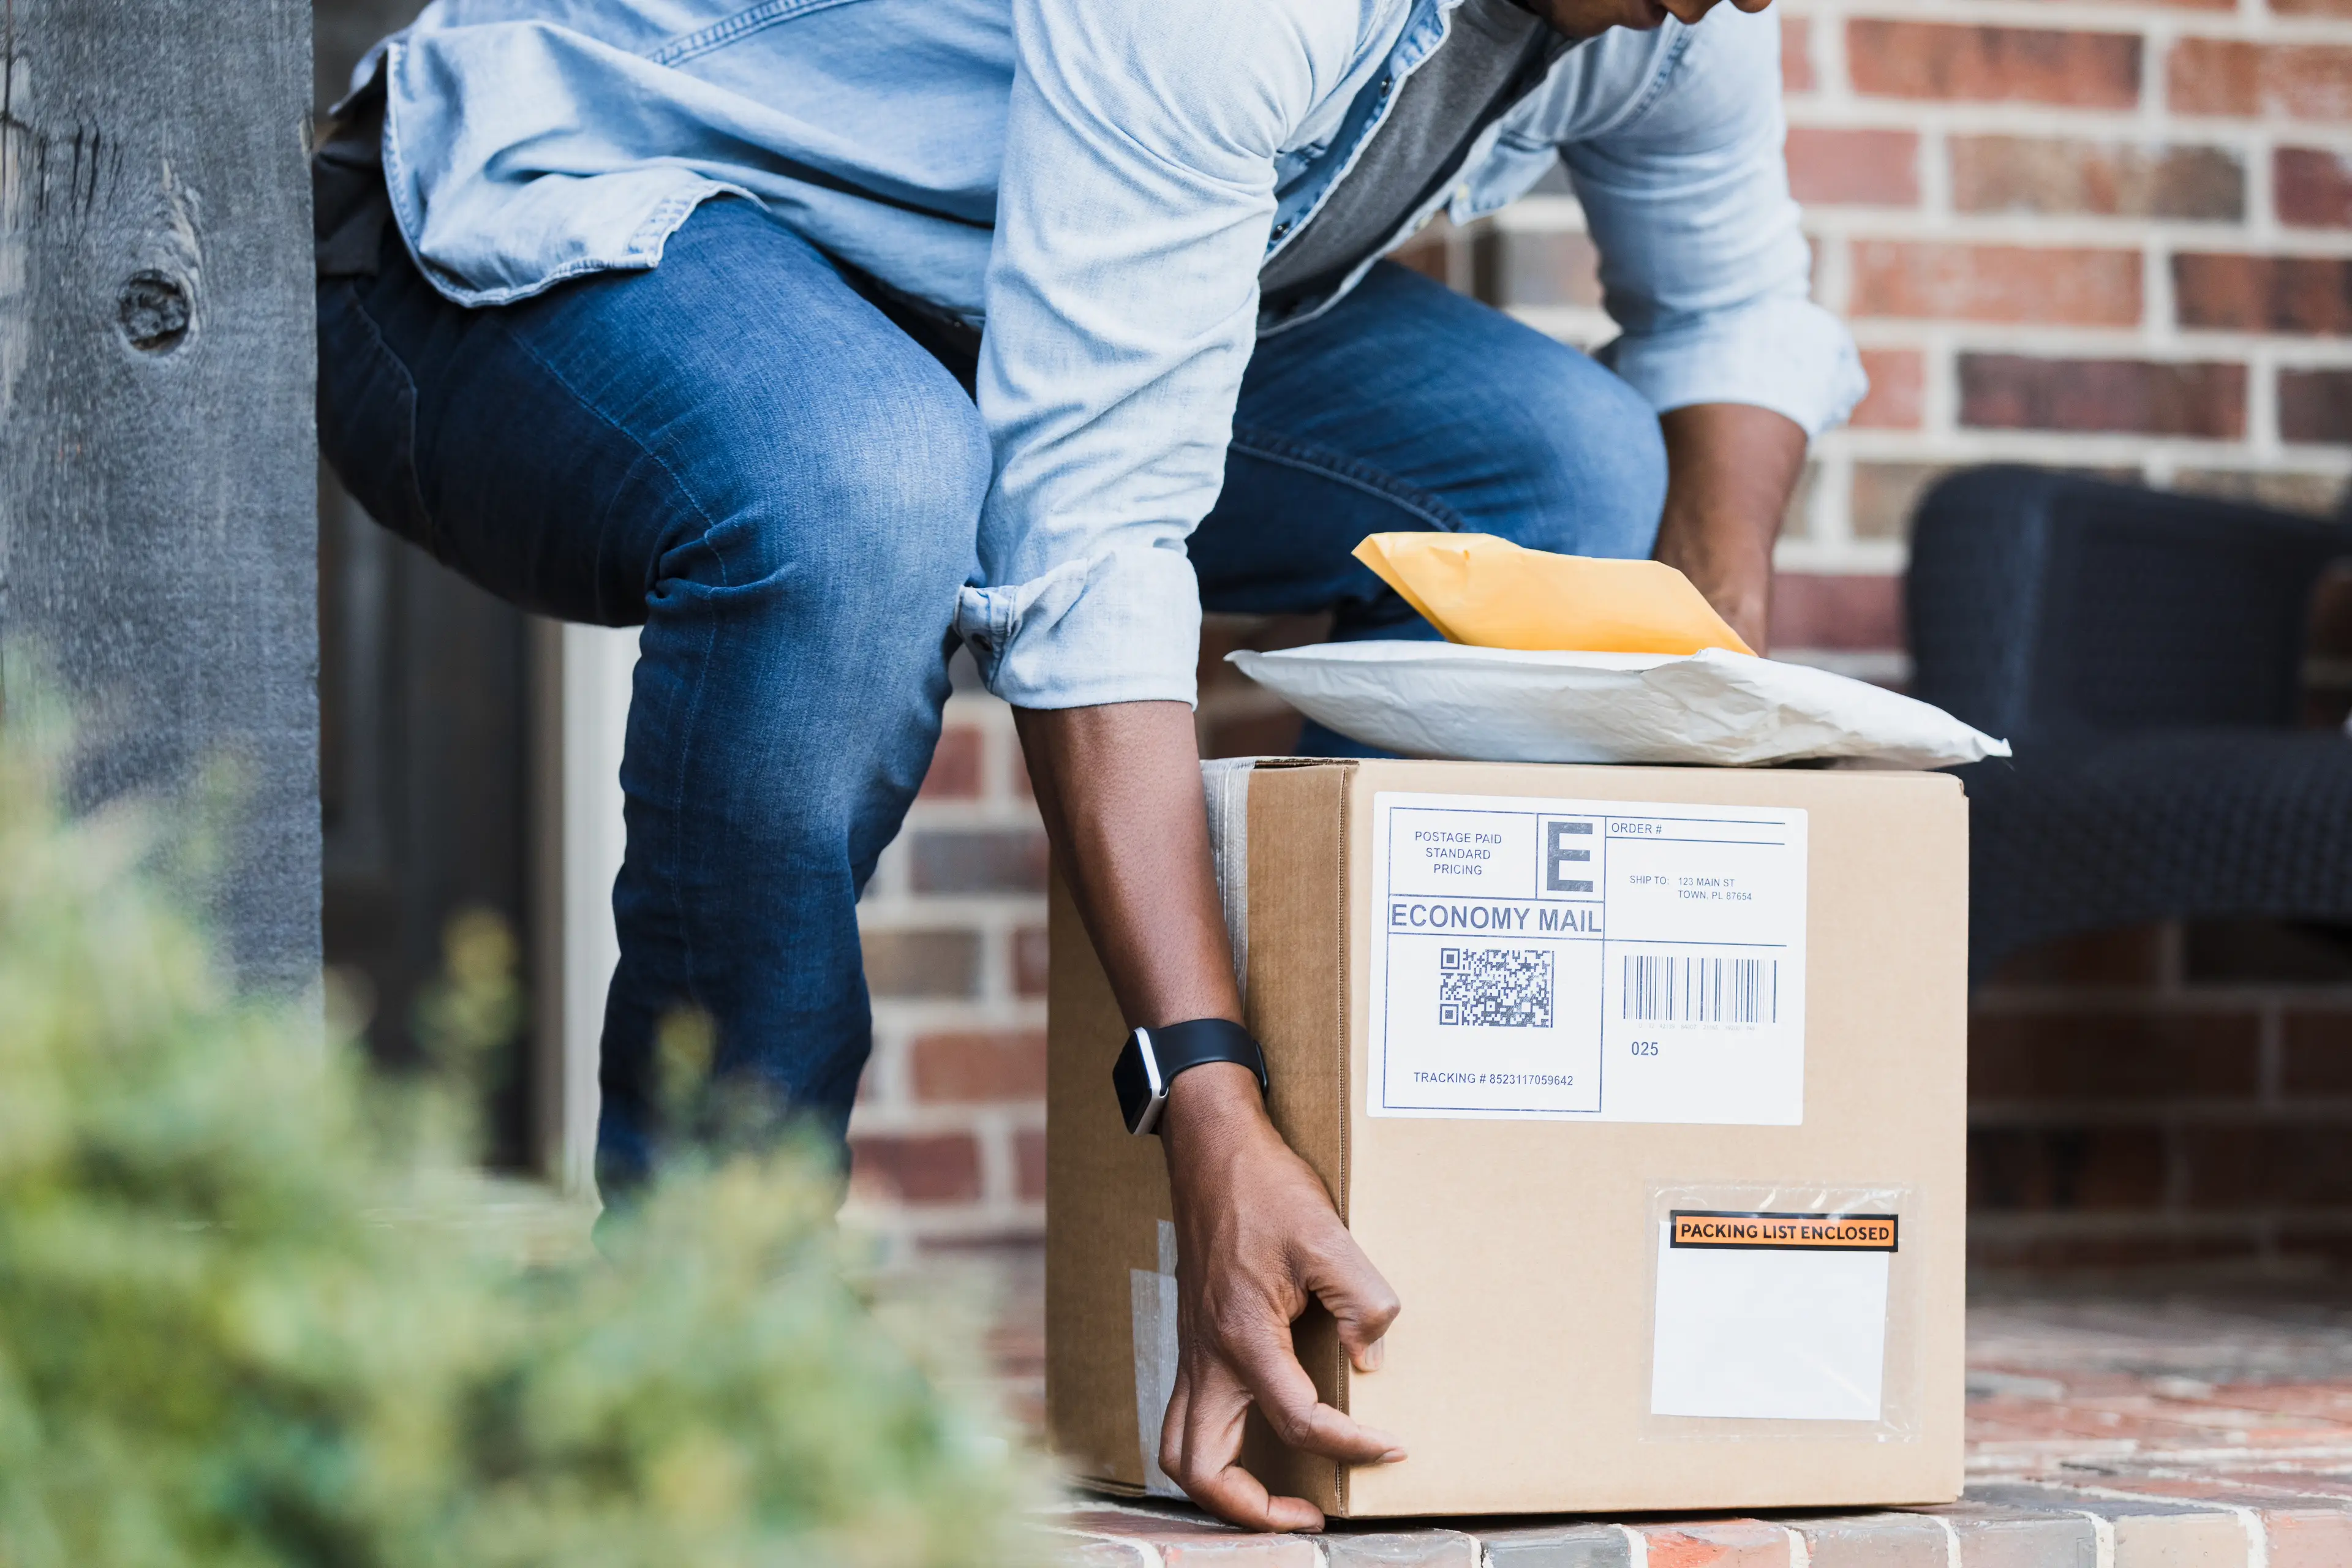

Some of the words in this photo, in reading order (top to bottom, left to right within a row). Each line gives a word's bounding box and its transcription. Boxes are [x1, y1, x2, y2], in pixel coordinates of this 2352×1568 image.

[1611, 823, 1652, 834] ORDER
[1656, 824, 1662, 834] #
[1415, 831, 1471, 843] POSTAGE
[1476, 833, 1502, 844] PAID
[1426, 847, 1490, 859] STANDARD
[1547, 821, 1594, 892] E
[1434, 864, 1482, 875] PRICING
[1630, 875, 1651, 884] SHIP
[1654, 876, 1670, 885] TO:
[1679, 877, 1694, 886] 123
[1697, 878, 1720, 886] MAIN
[1723, 878, 1735, 887] ST
[1678, 890, 1708, 900] TOWN,
[1712, 891, 1723, 900] PL
[1726, 892, 1752, 900] 87654
[1392, 903, 1531, 930] ECONOMY
[1539, 908, 1602, 933] MAIL
[1631, 1041, 1659, 1056] 025
[1414, 1072, 1476, 1084] TRACKING
[1479, 1073, 1487, 1084] #
[1490, 1074, 1573, 1085] 8523117059642
[1681, 1223, 1758, 1238] PACKING
[1763, 1225, 1796, 1239] LIST
[1801, 1226, 1890, 1240] ENCLOSED
